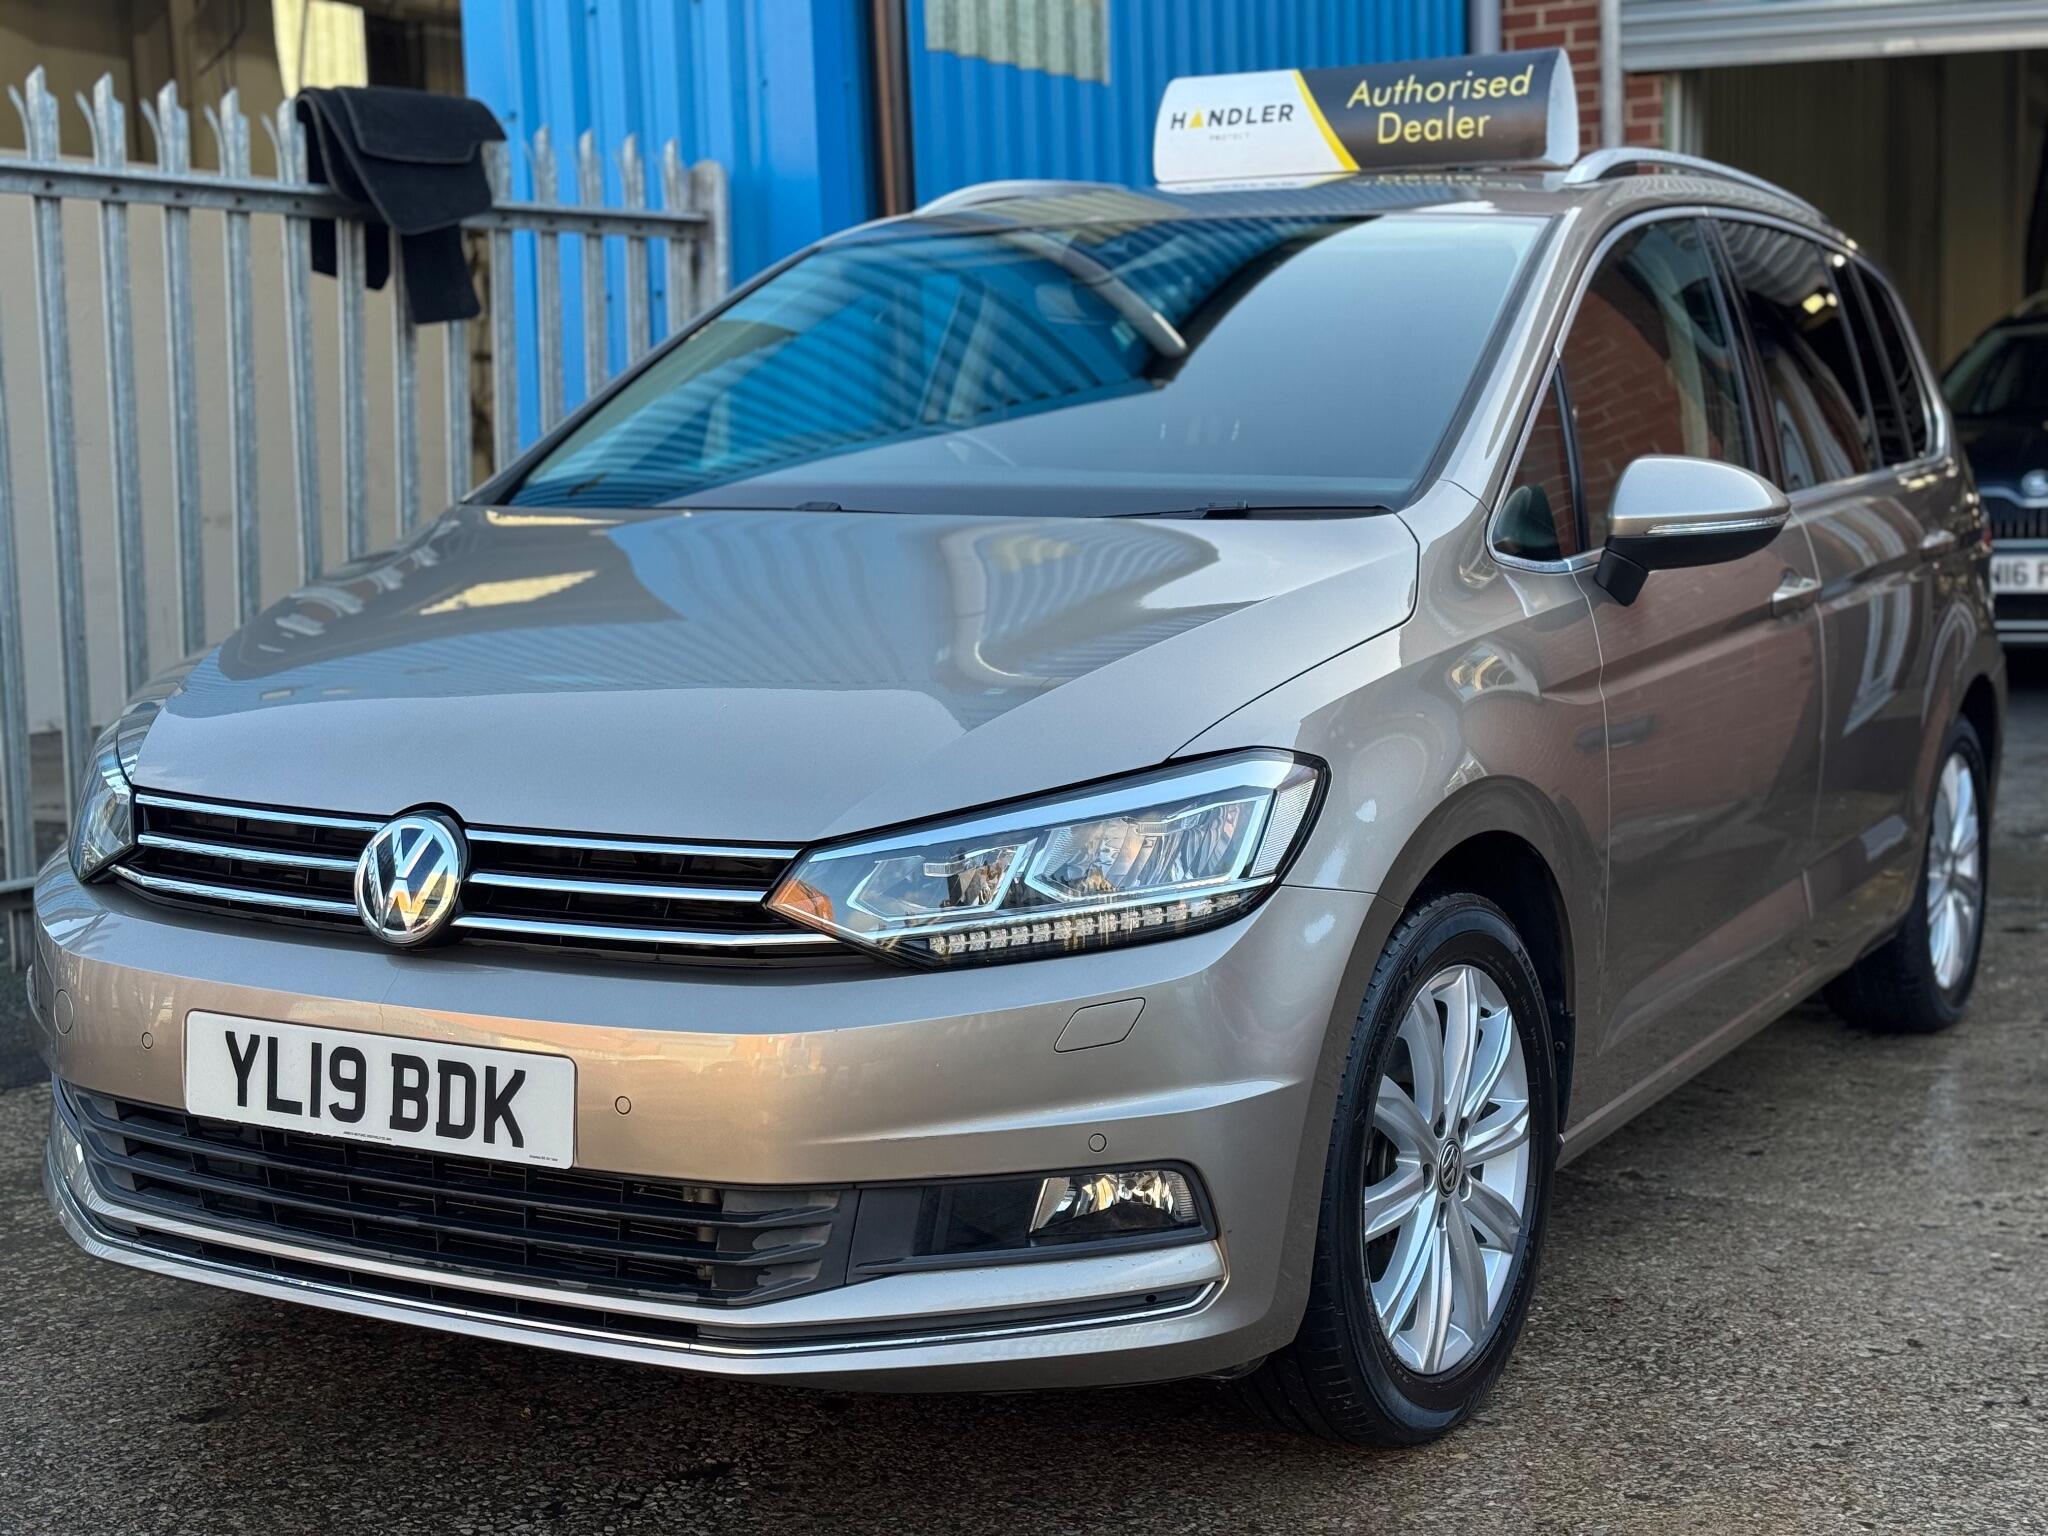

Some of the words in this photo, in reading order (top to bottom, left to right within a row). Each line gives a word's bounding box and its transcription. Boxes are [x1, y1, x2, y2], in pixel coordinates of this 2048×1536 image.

[1346, 65, 1534, 109] Authorised
[1170, 104, 1294, 129] HANDLER
[1377, 106, 1491, 144] Dealer
[225, 1031, 366, 1123] YL19
[389, 1053, 526, 1148] BDK
